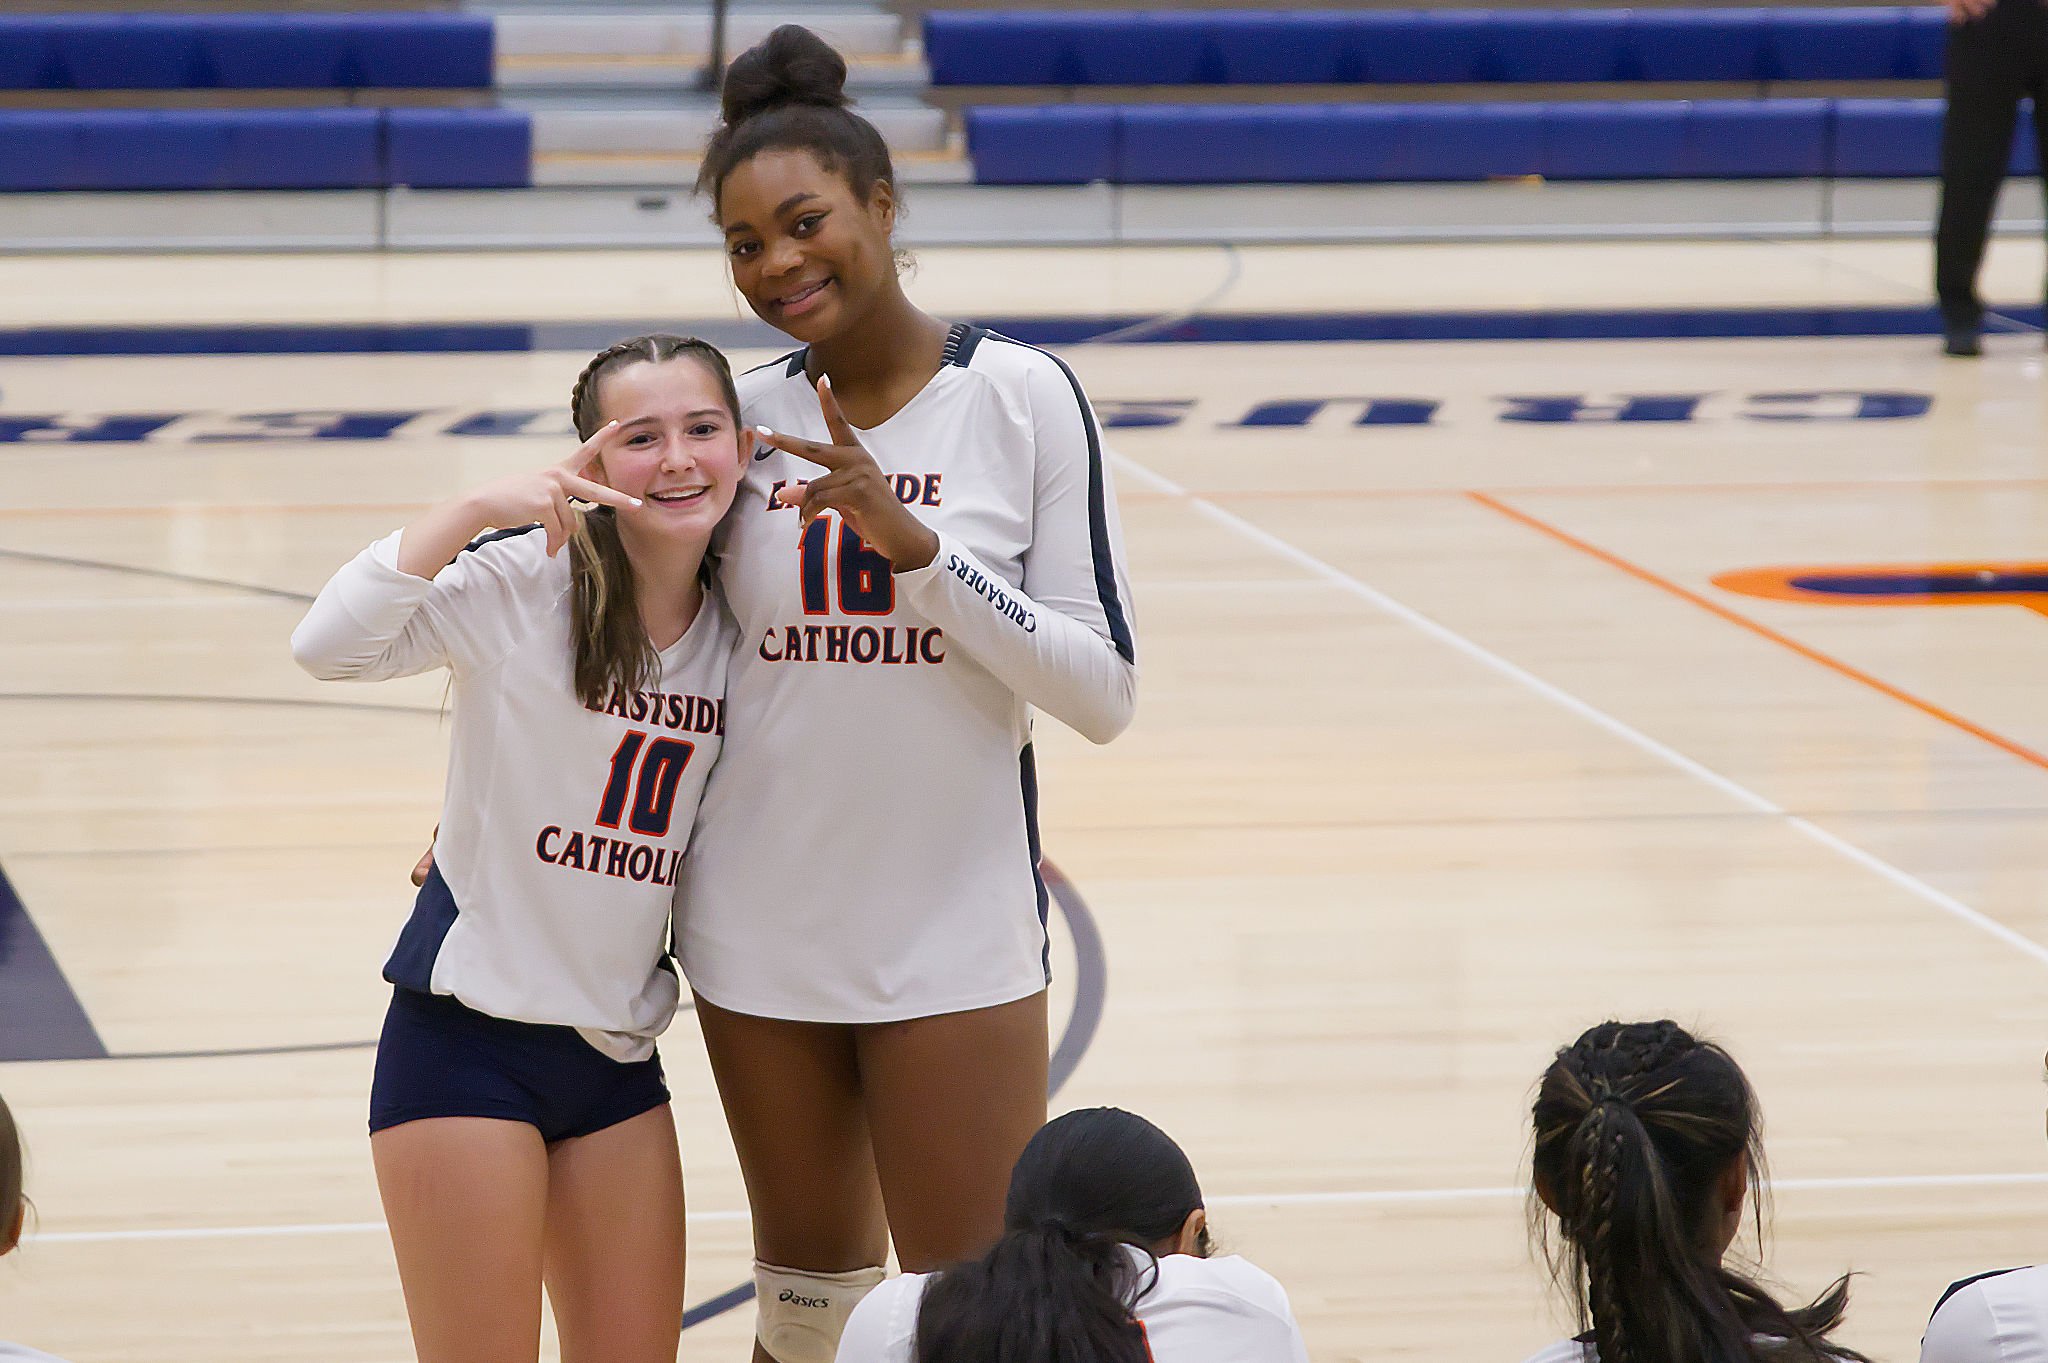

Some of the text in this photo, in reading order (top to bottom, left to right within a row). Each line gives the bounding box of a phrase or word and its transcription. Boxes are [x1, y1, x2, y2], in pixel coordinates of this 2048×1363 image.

[797, 514, 896, 616] 16
[947, 554, 1036, 633] CRUSADERS
[759, 624, 946, 665] CATHOLIC
[595, 729, 695, 838] 10
